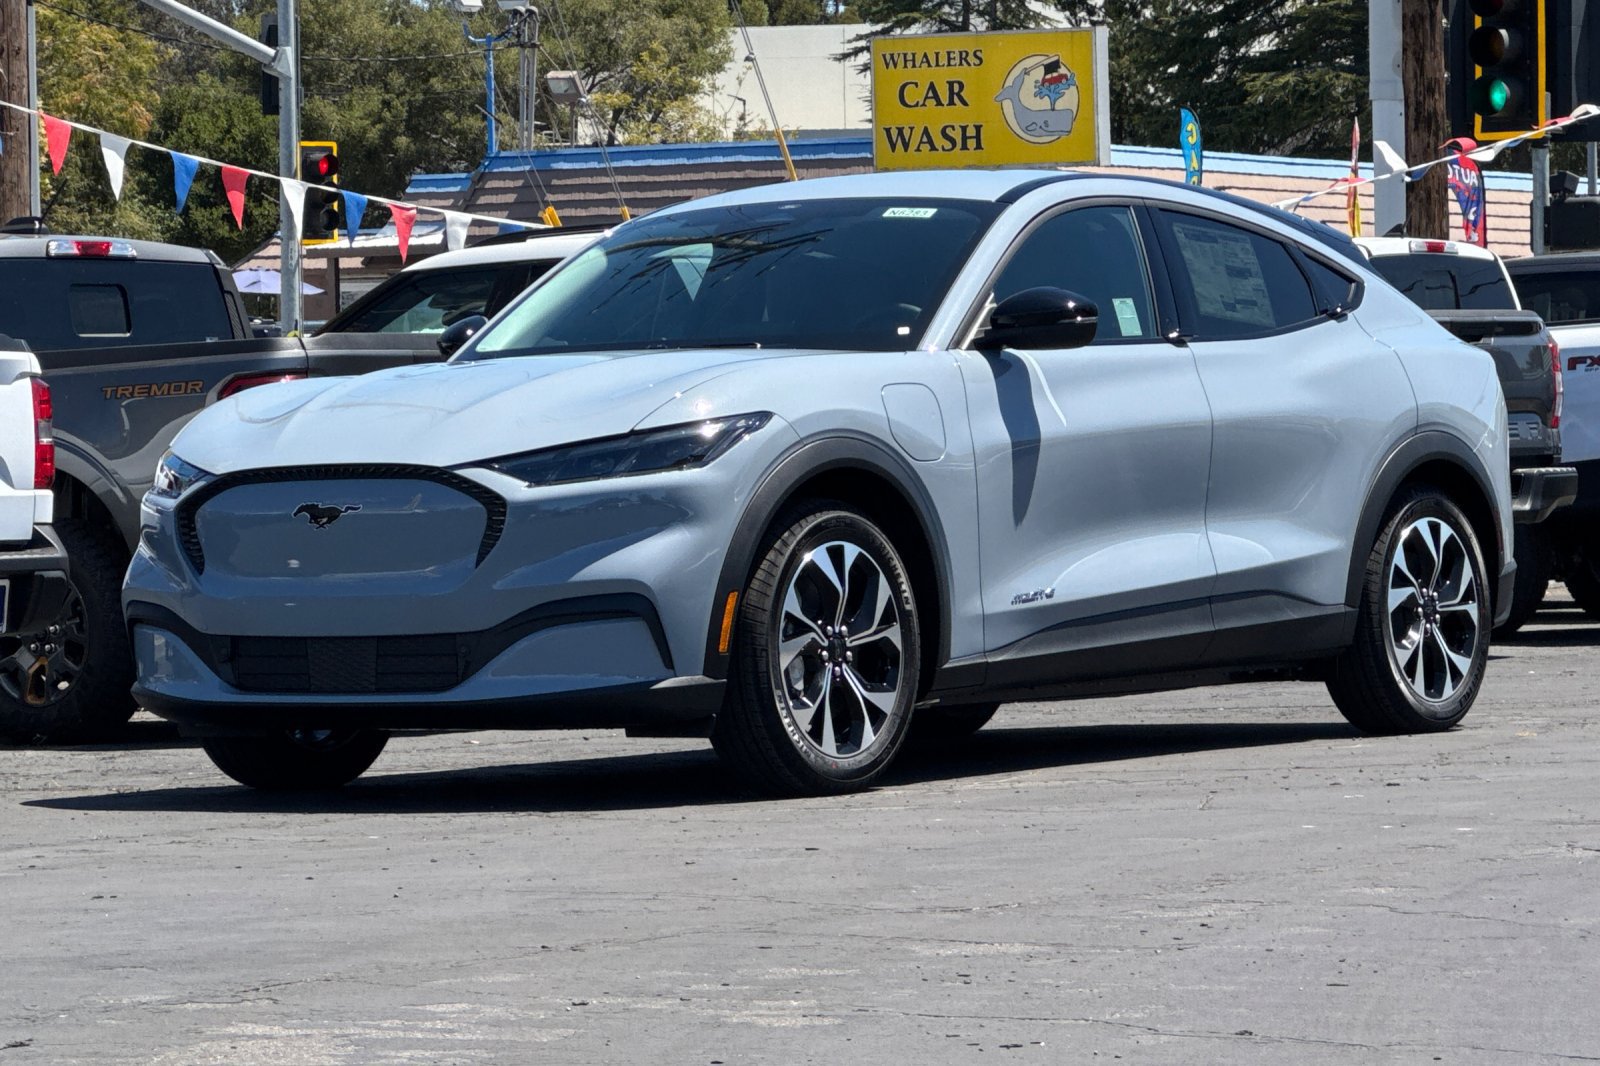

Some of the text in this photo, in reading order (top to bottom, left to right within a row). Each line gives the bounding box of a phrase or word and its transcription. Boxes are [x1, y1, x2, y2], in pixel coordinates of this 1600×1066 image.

[882, 50, 984, 70] WHALERS
[898, 80, 970, 108] CAR
[883, 124, 984, 153] WASH
[102, 380, 204, 400] TREMOR
